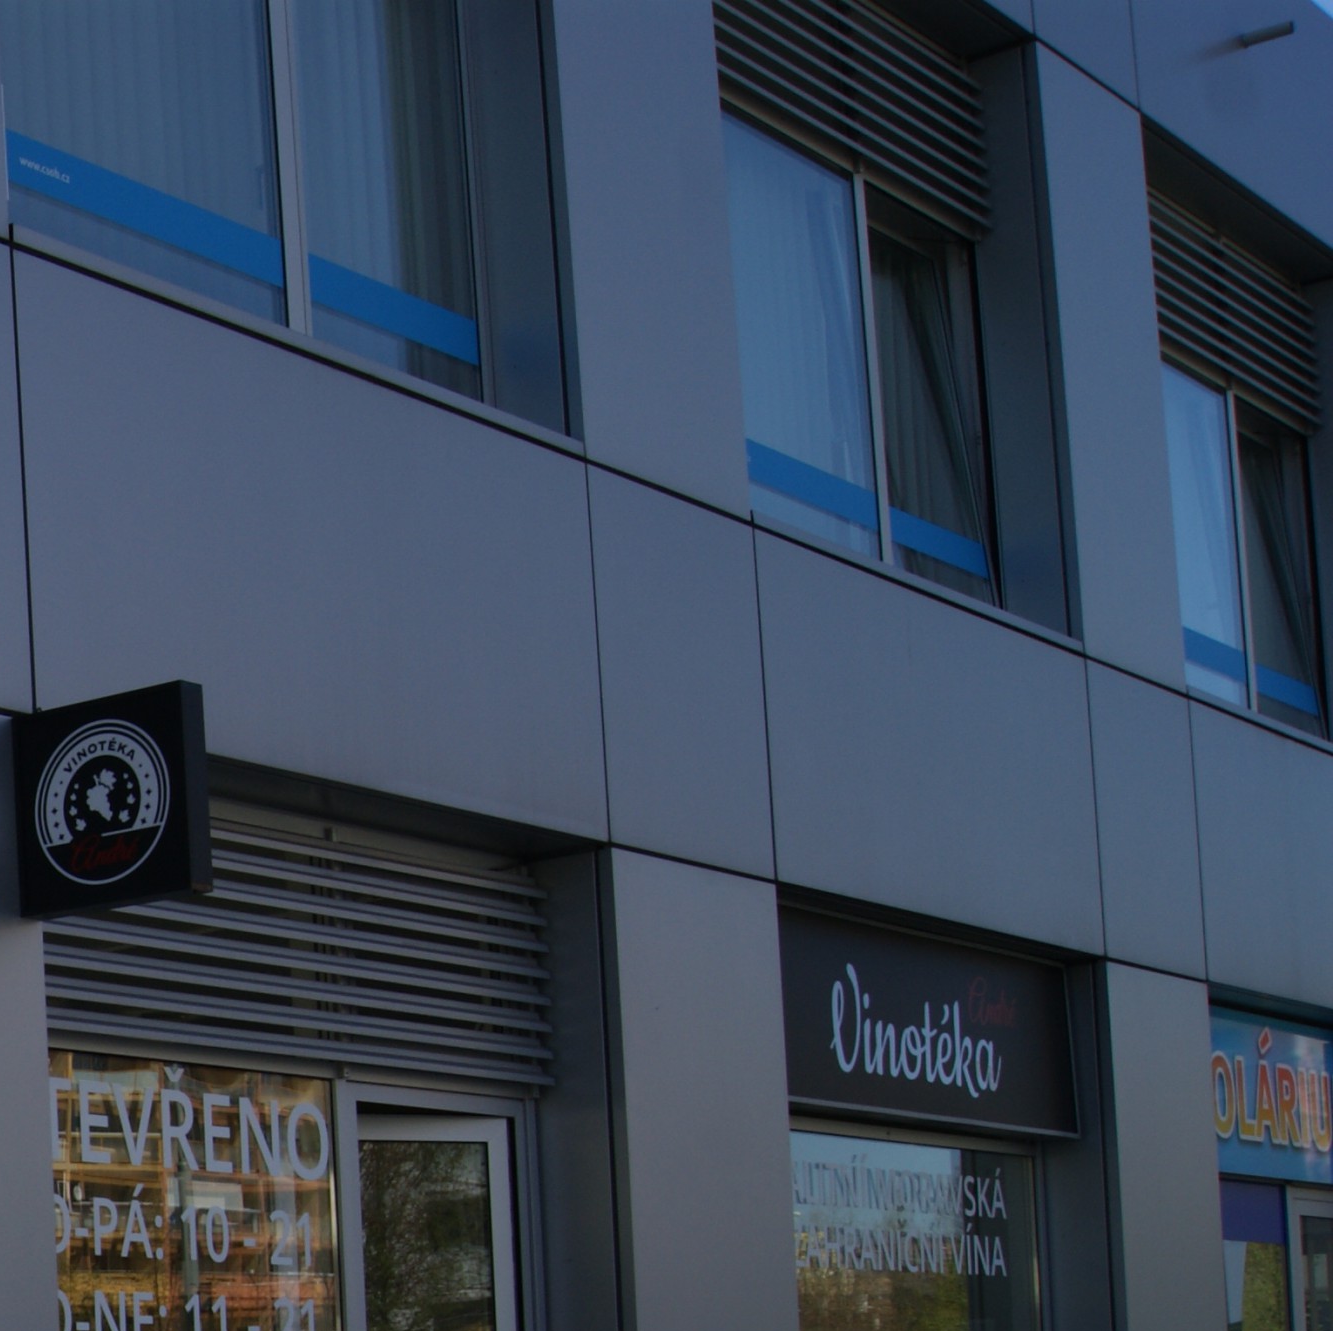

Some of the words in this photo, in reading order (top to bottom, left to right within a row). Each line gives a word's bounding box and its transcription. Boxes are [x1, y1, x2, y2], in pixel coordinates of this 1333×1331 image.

[63, 737, 137, 774] VINOTÉKA
[830, 963, 1003, 1099] Vinotéka
[181, 1204, 231, 1264] 10
[269, 1210, 313, 1268] 21
[947, 1222, 1008, 1277] VÍNA
